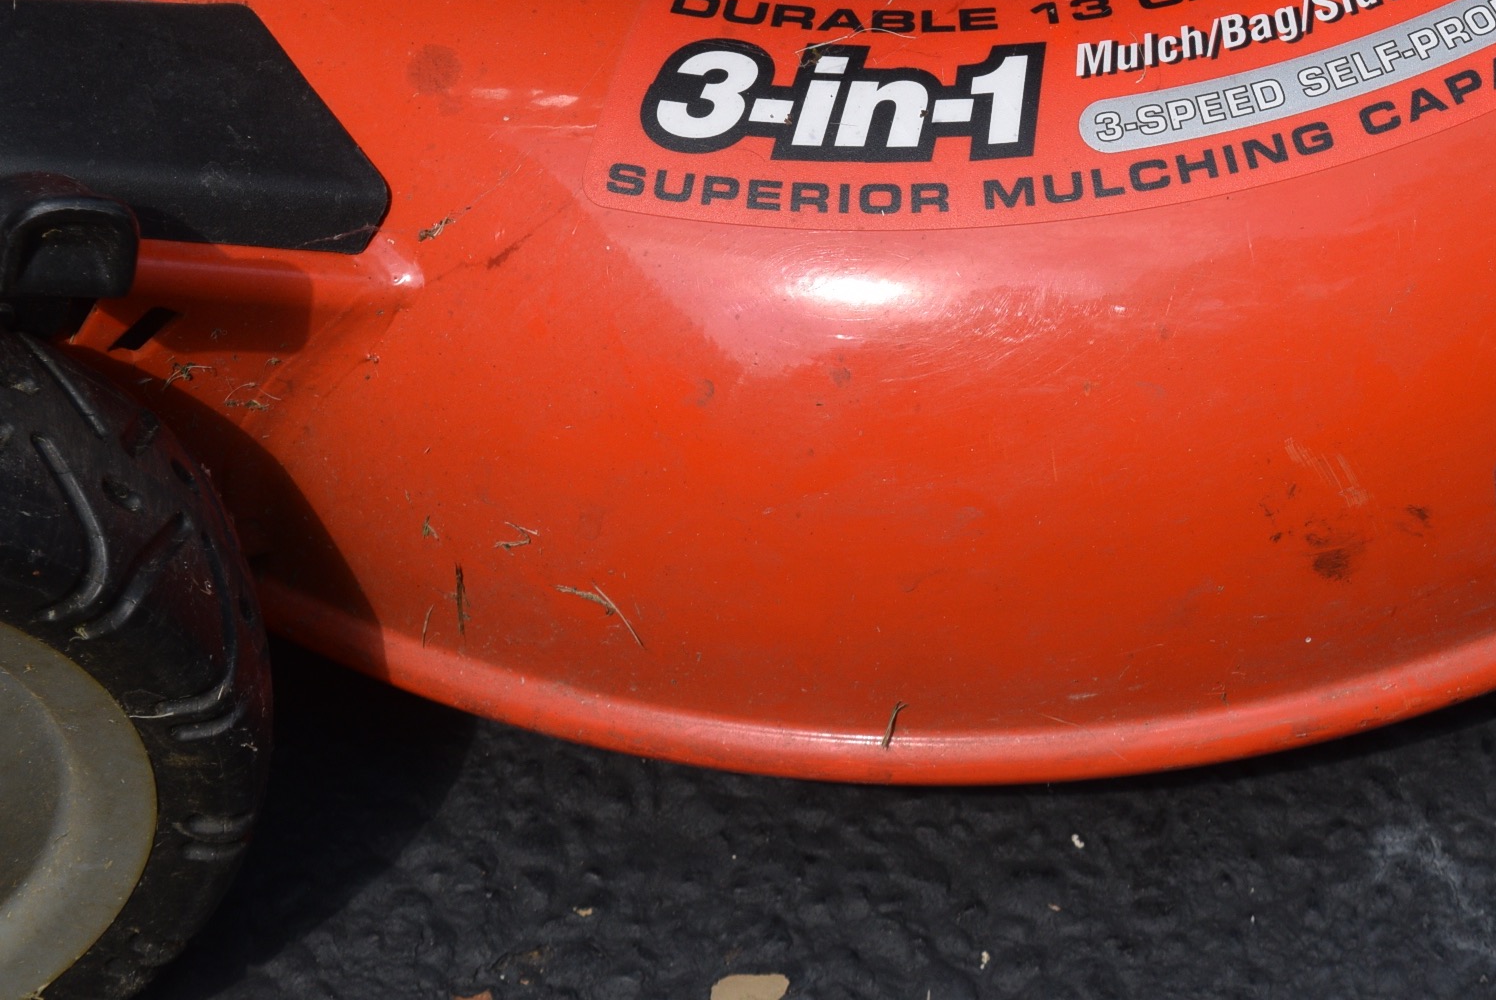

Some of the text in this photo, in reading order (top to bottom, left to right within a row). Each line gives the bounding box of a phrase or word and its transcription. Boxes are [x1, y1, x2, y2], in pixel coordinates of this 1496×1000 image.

[646, 43, 1040, 152] 3-in-1
[1093, 77, 1286, 143] 3-SPEED
[606, 162, 951, 215] SUPERIOR
[983, 120, 1335, 209] MULCHING
